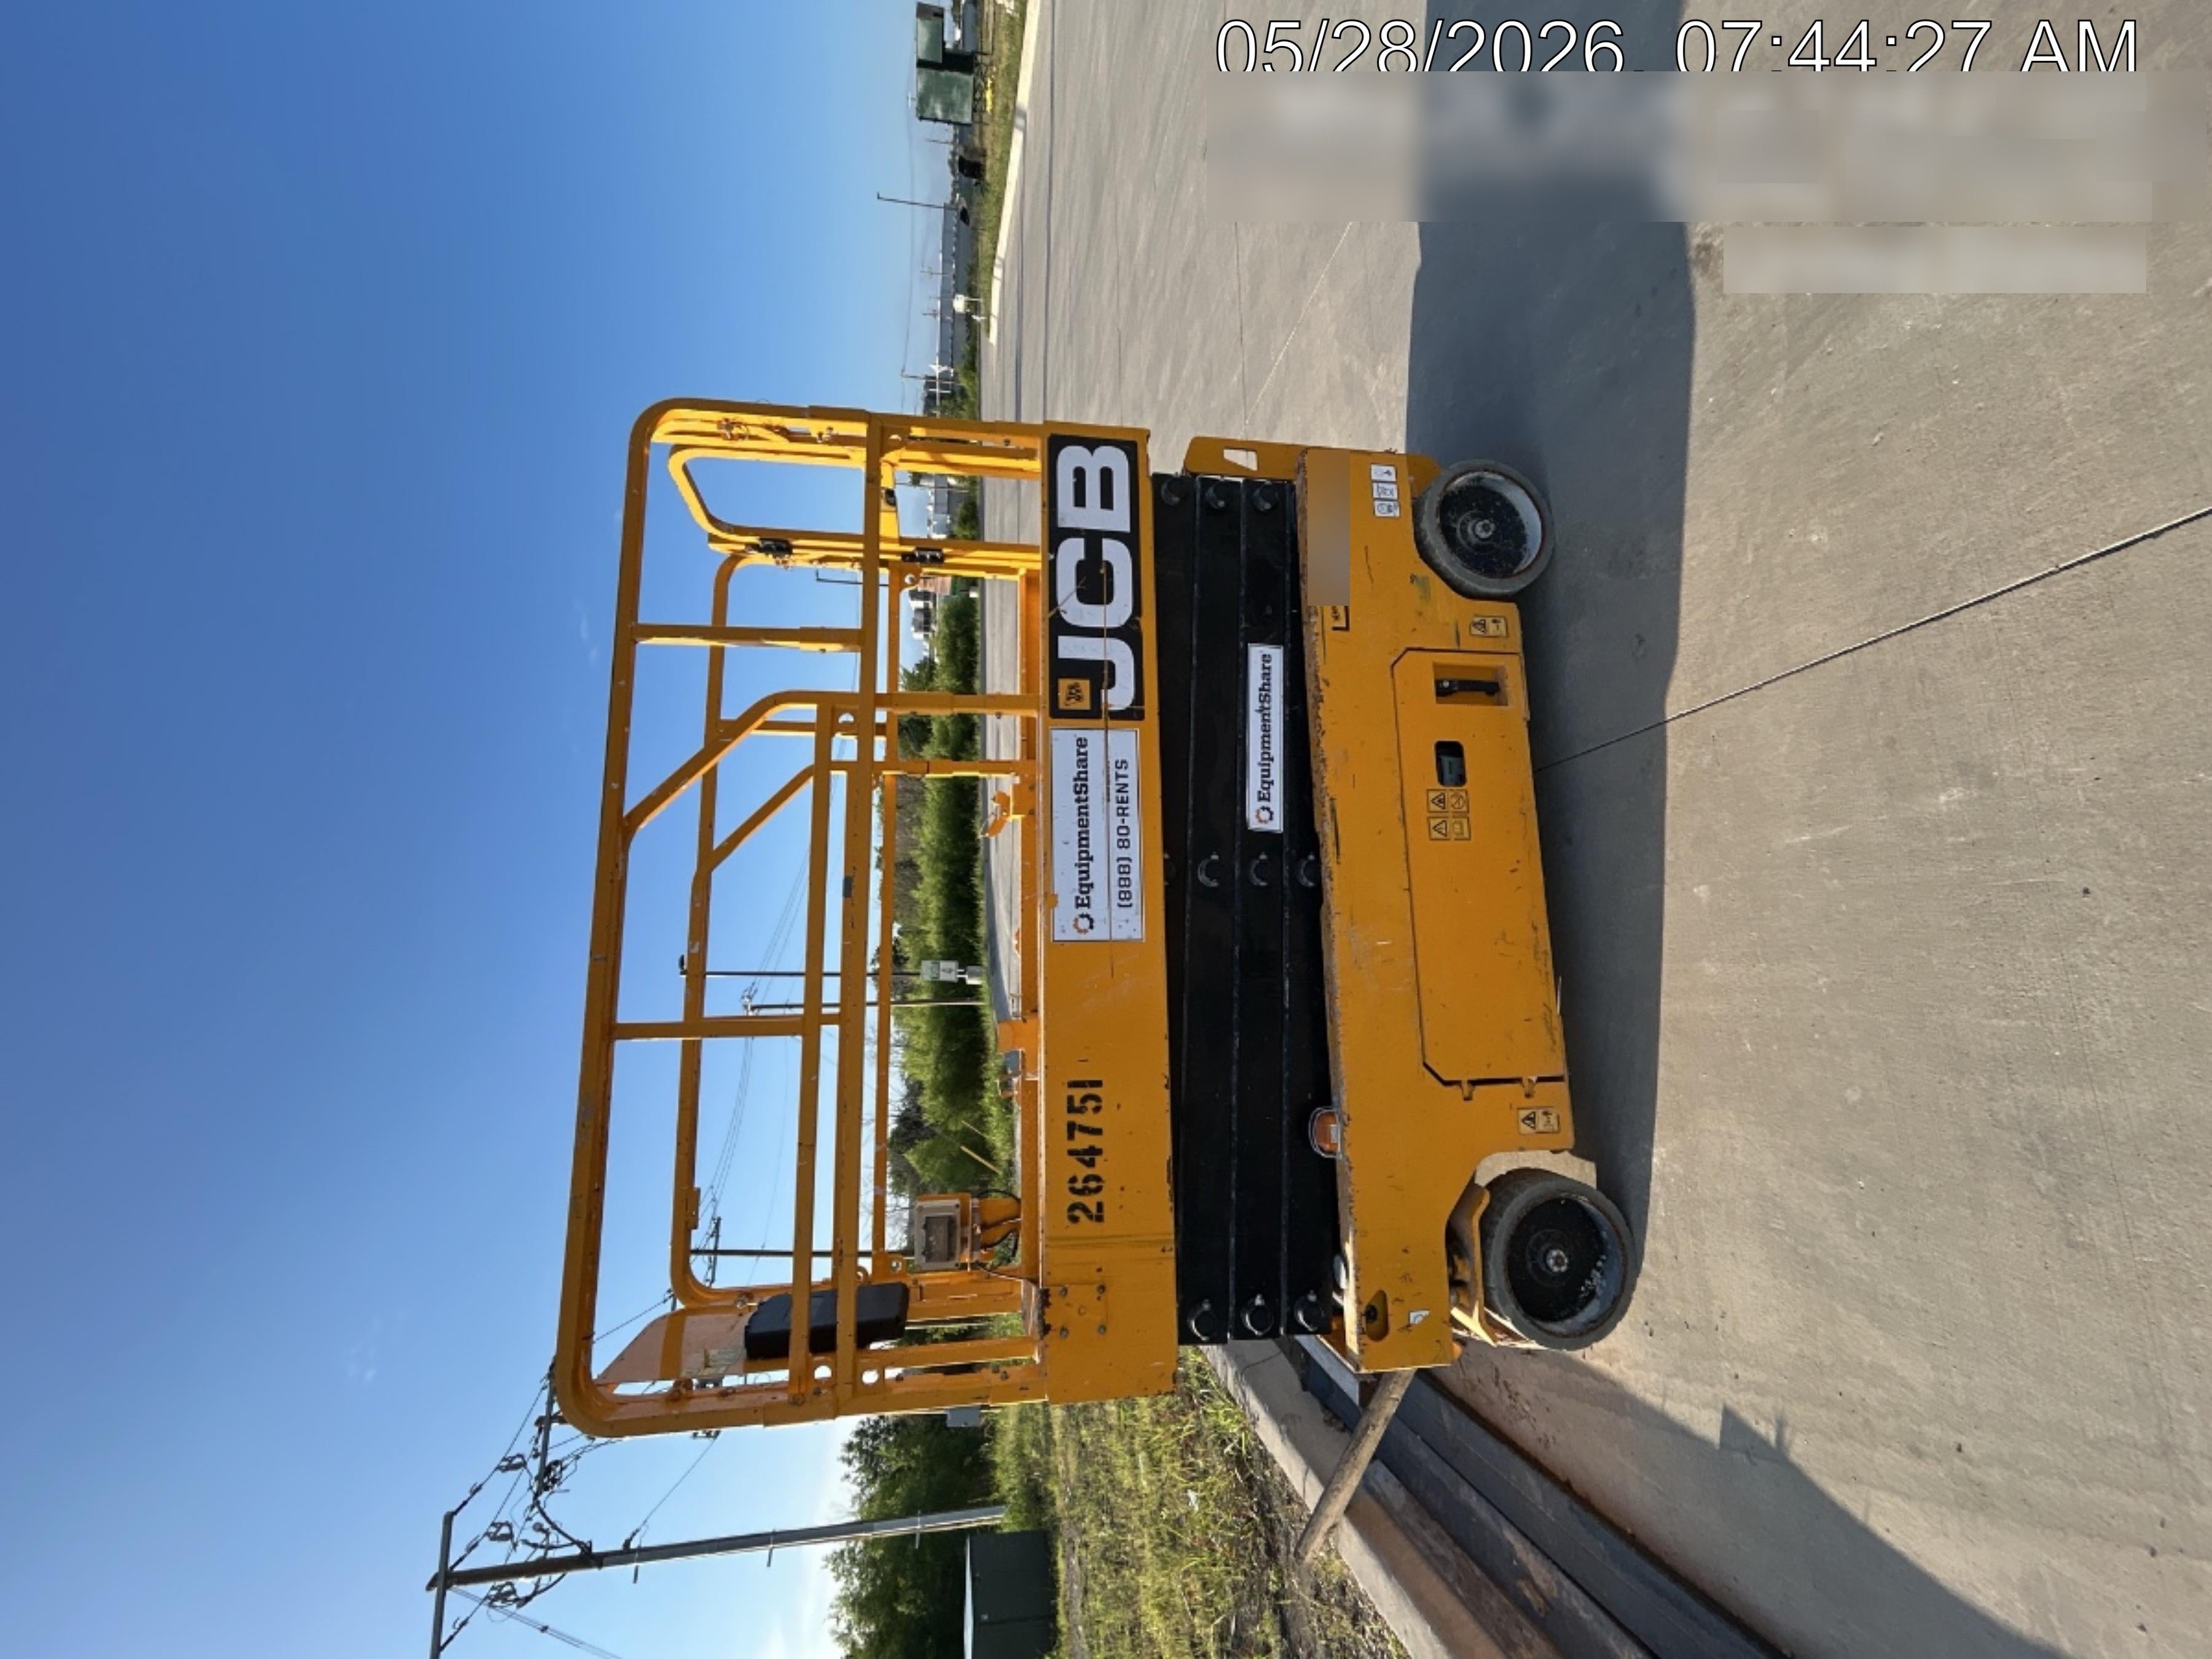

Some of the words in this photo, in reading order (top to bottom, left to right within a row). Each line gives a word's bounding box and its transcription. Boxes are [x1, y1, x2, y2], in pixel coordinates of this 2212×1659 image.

[1056, 445, 1134, 710] JCB
[1257, 654, 1274, 802] EquipmentShare
[1073, 737, 1093, 909] EquipmentShare
[1115, 758, 1131, 850] 80-RENTS
[1116, 856, 1133, 908] (888)
[1067, 1080, 1104, 1224] 264751
